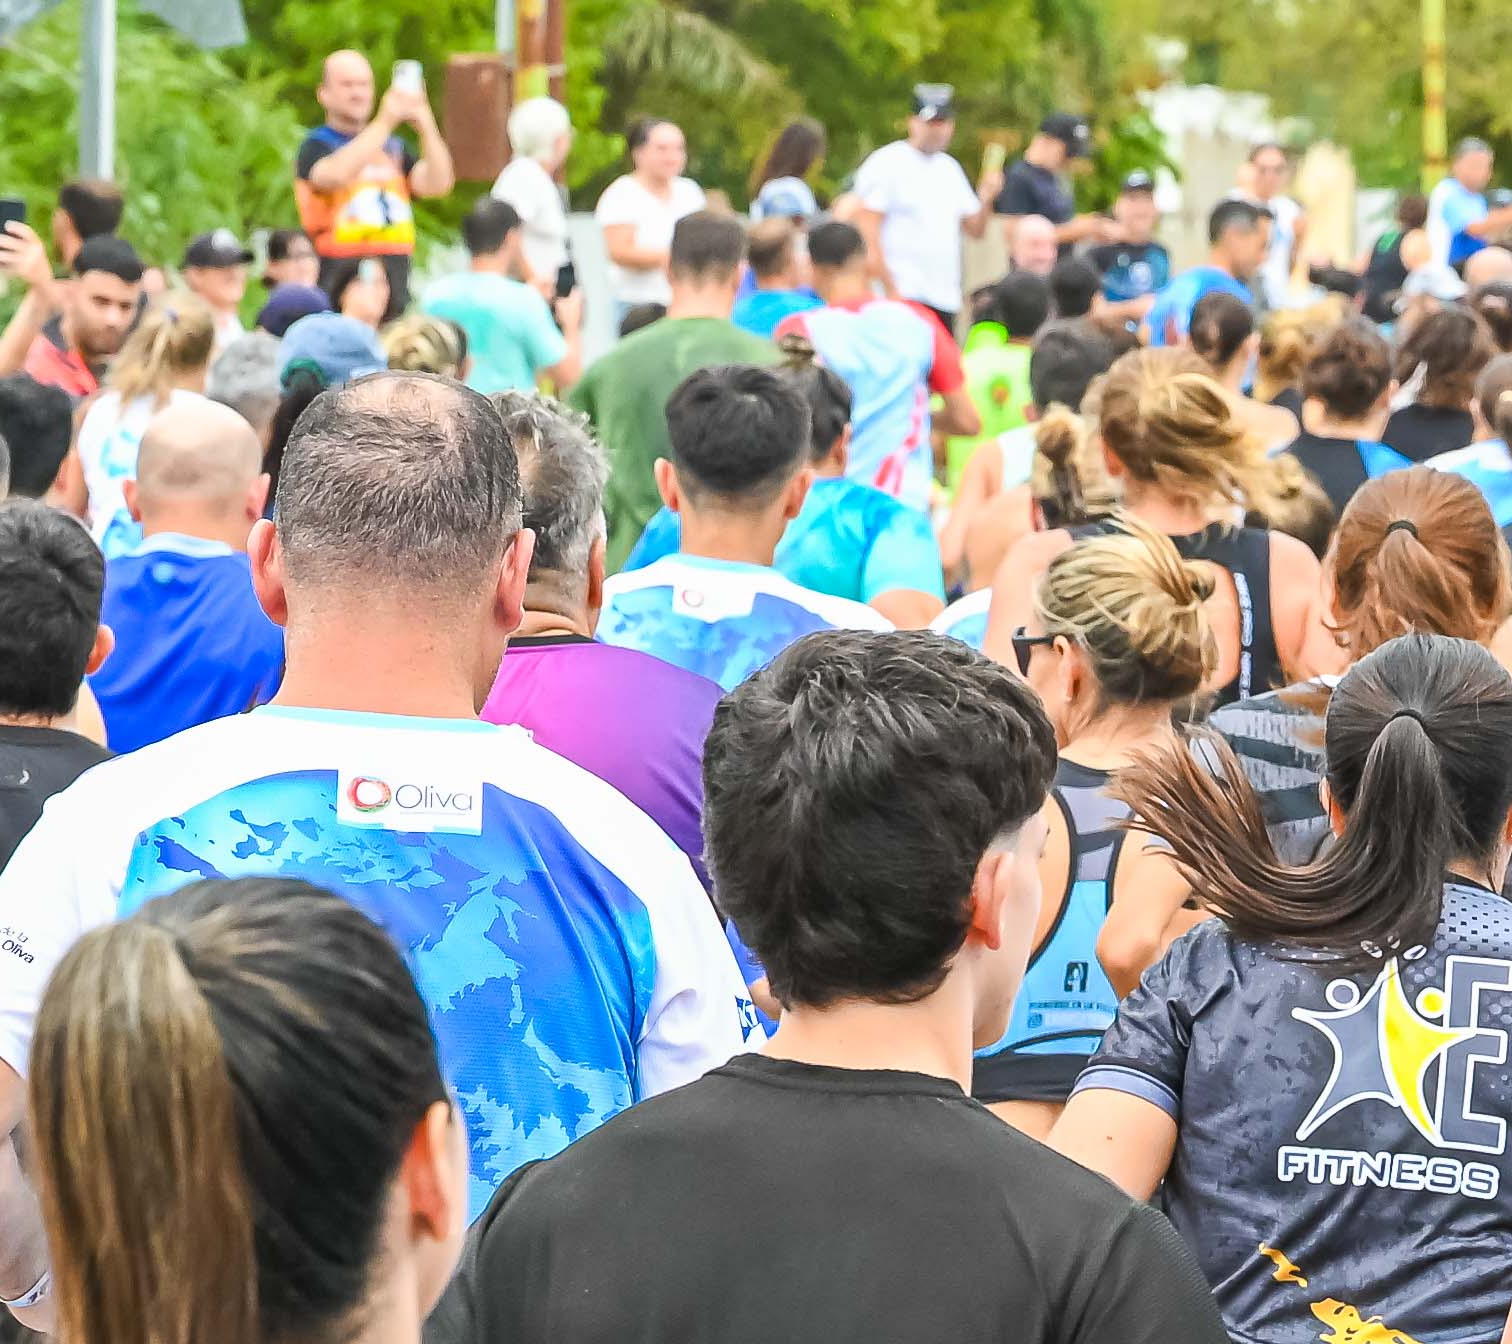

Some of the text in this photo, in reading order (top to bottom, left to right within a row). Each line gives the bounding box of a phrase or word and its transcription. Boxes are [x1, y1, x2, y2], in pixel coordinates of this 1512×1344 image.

[395, 784, 473, 811] Oliva
[1, 939, 35, 964] Oliva
[1277, 1145, 1501, 1200] FITNESS
